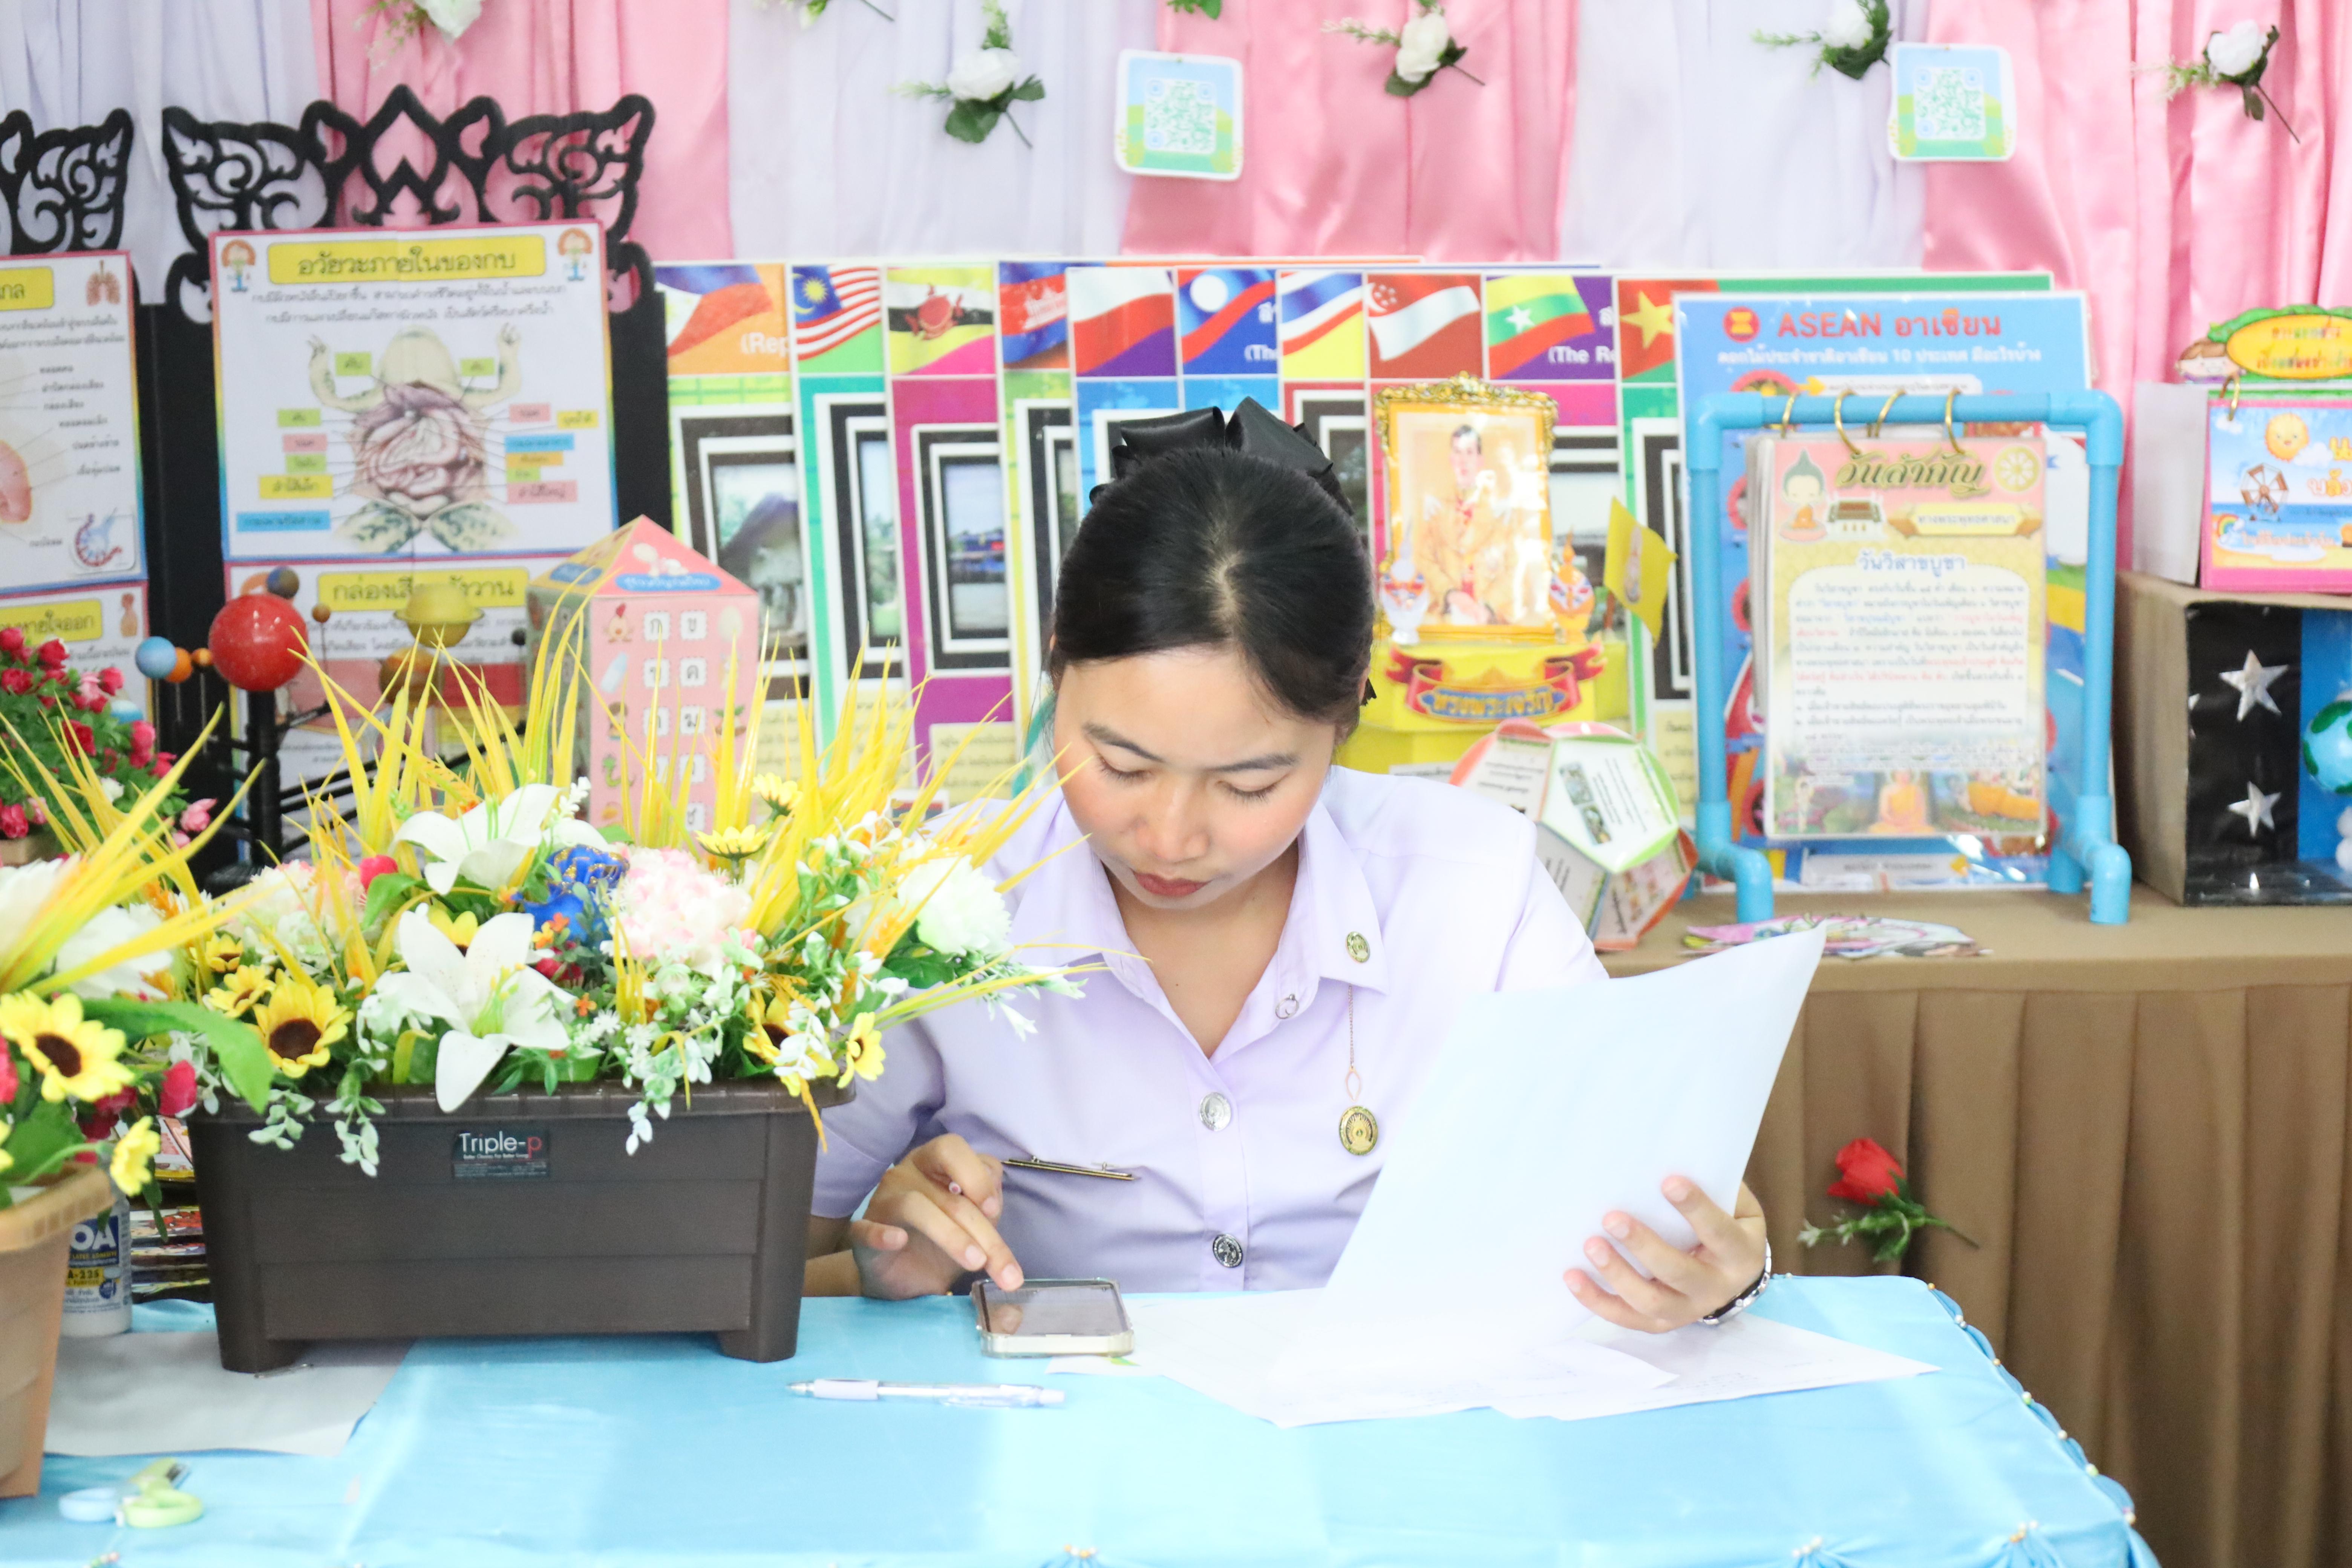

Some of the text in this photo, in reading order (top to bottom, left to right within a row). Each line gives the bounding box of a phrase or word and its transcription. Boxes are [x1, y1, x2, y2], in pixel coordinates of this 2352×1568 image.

[297, 248, 516, 277] อวัยวะภายในของกบ
[1778, 308, 2001, 338] ASEAN อาเซียน
[1548, 345, 1591, 364] (The
[1893, 349, 1911, 363] 10
[1916, 348, 1968, 363] ประเทศ
[1972, 341, 2042, 363] มีอะไรบ้าง
[1916, 511, 2015, 527] ทางพระพุทธศาสนา
[1858, 551, 1966, 577] วันวิสาขบูชา
[687, 617, 697, 632] ข
[459, 1131, 543, 1159] Triple-p
[70, 1222, 117, 1251] OA
